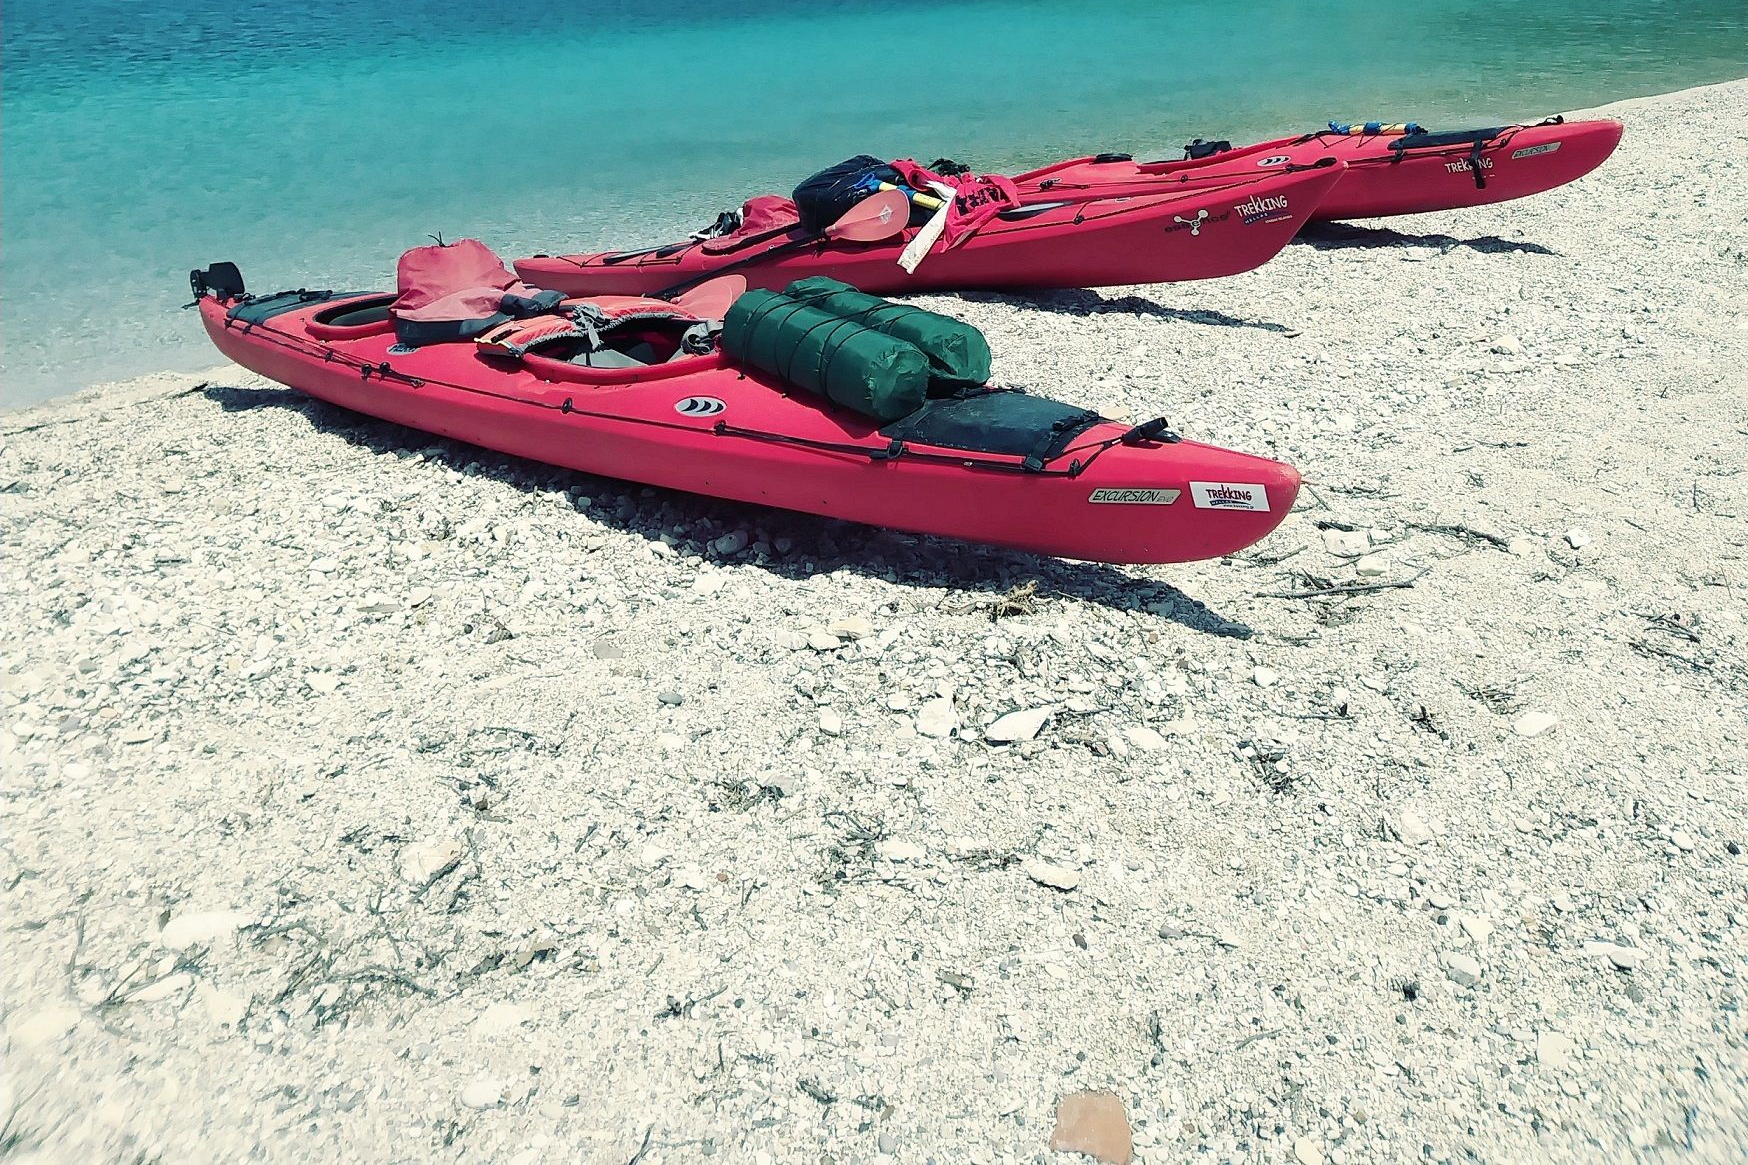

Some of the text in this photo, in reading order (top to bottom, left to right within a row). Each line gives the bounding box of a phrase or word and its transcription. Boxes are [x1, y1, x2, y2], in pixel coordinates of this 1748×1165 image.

[1444, 157, 1493, 173] TREKNG
[1234, 195, 1288, 217] TREKKING
[1092, 490, 1160, 502] EXCURSION
[1205, 484, 1252, 501] TREKKING
